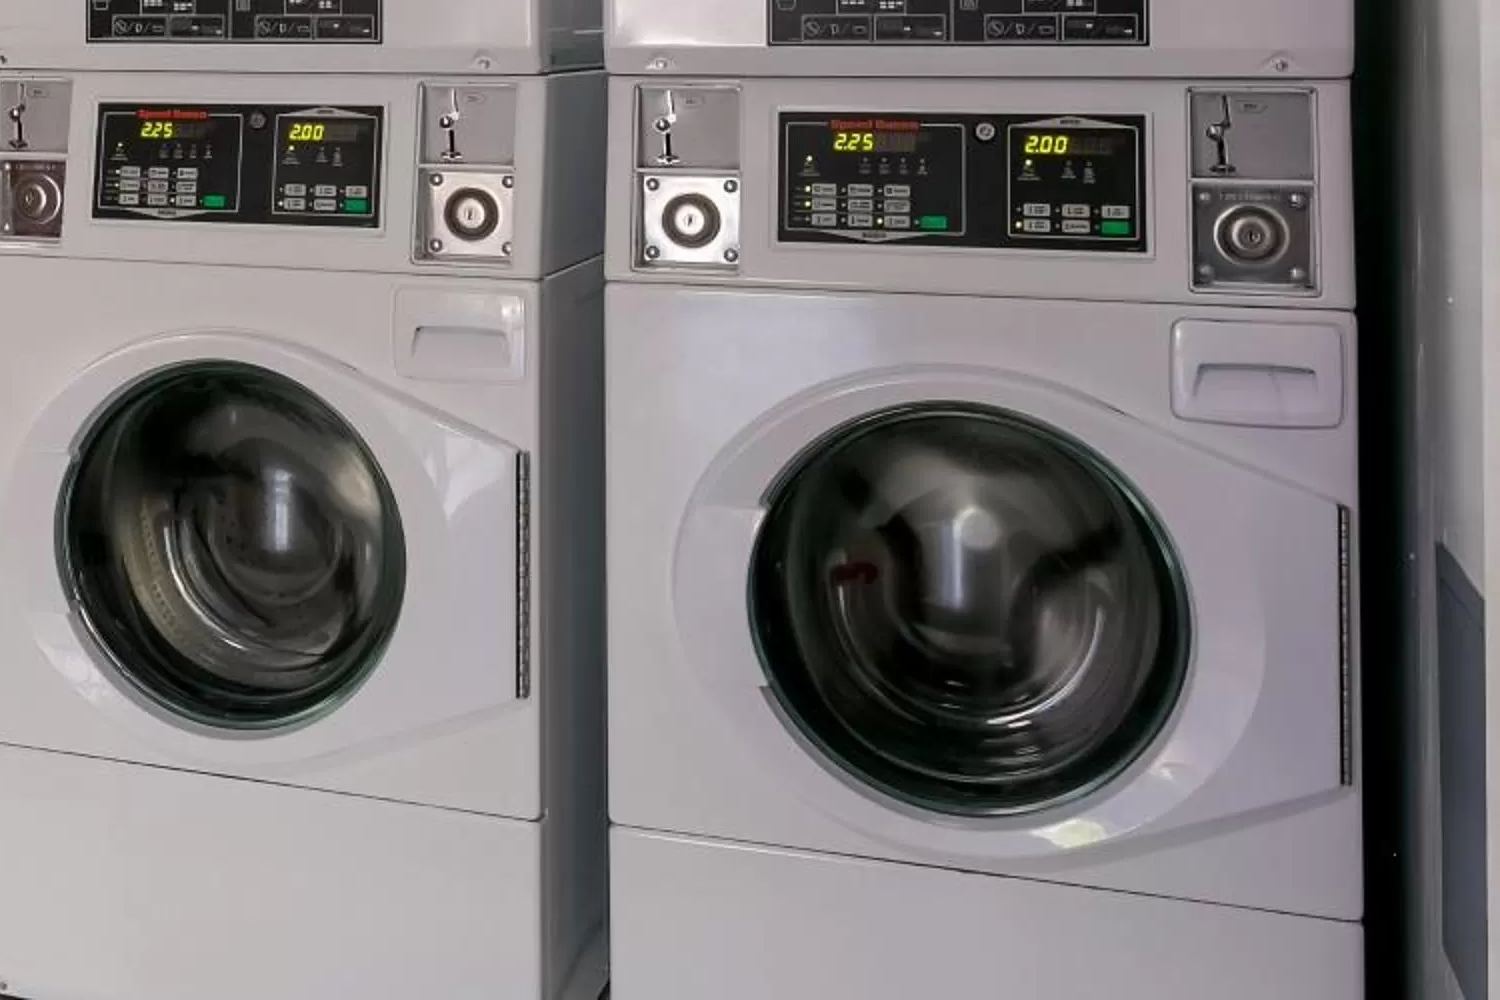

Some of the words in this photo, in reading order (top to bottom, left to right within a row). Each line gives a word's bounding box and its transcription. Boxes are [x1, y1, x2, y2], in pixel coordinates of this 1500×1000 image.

[288, 123, 325, 141] 2.00
[833, 132, 874, 151] 2.25
[1024, 135, 1069, 154] 2.00
